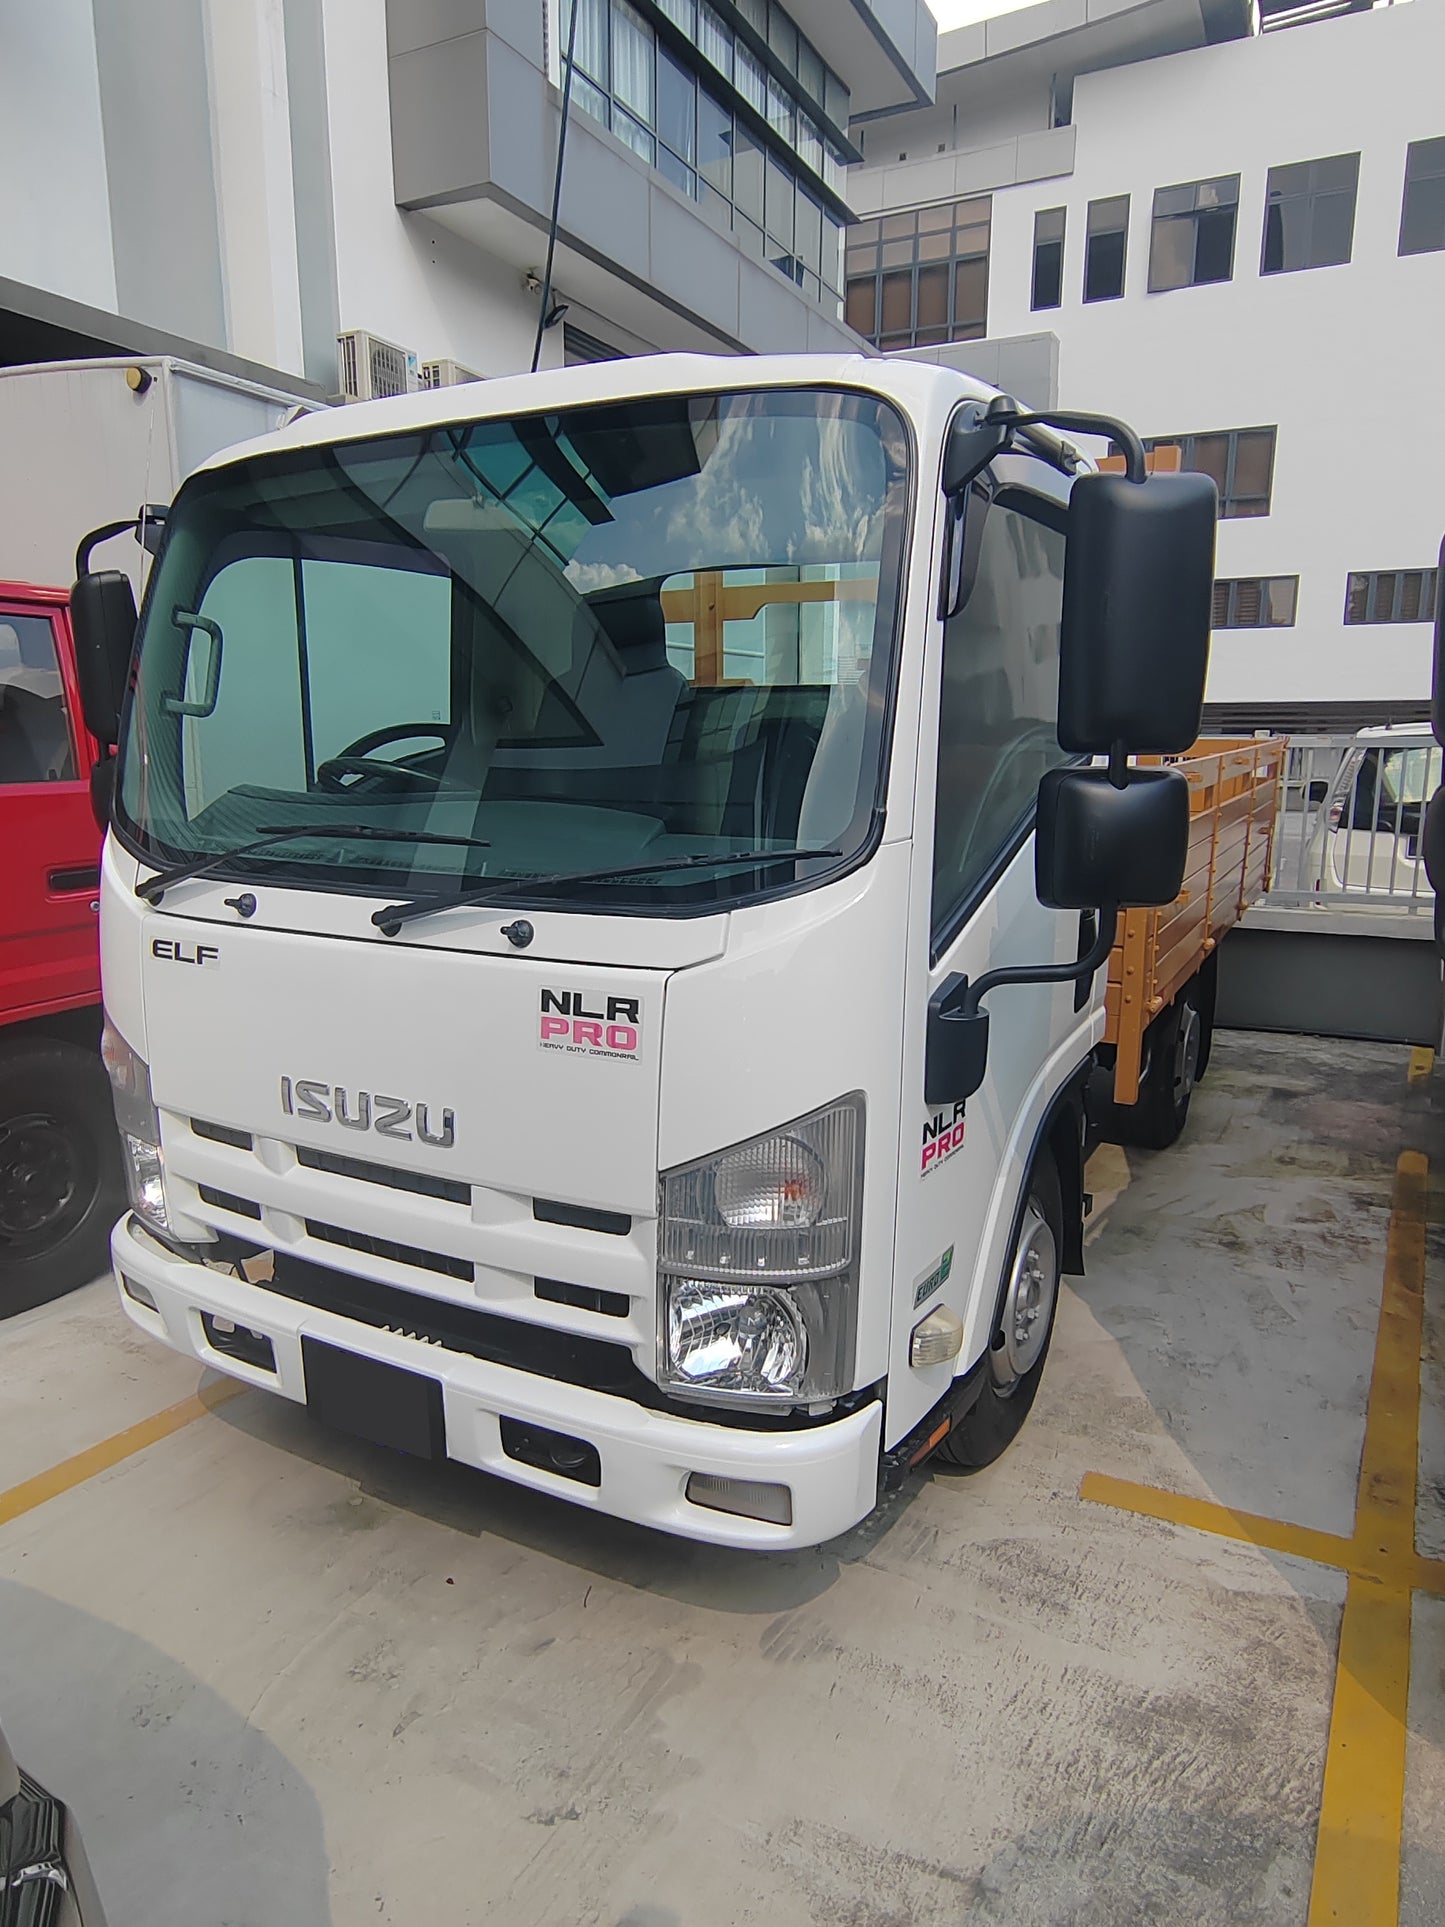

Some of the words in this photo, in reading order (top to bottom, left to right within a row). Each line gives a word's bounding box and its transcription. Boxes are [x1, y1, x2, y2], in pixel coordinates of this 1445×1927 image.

[153, 939, 218, 965] ELF
[541, 989, 639, 1024] NLR
[541, 1016, 638, 1051] PRO
[281, 1075, 456, 1149] ISUZU
[922, 1099, 966, 1145] NLR
[921, 1122, 965, 1171] PRO
